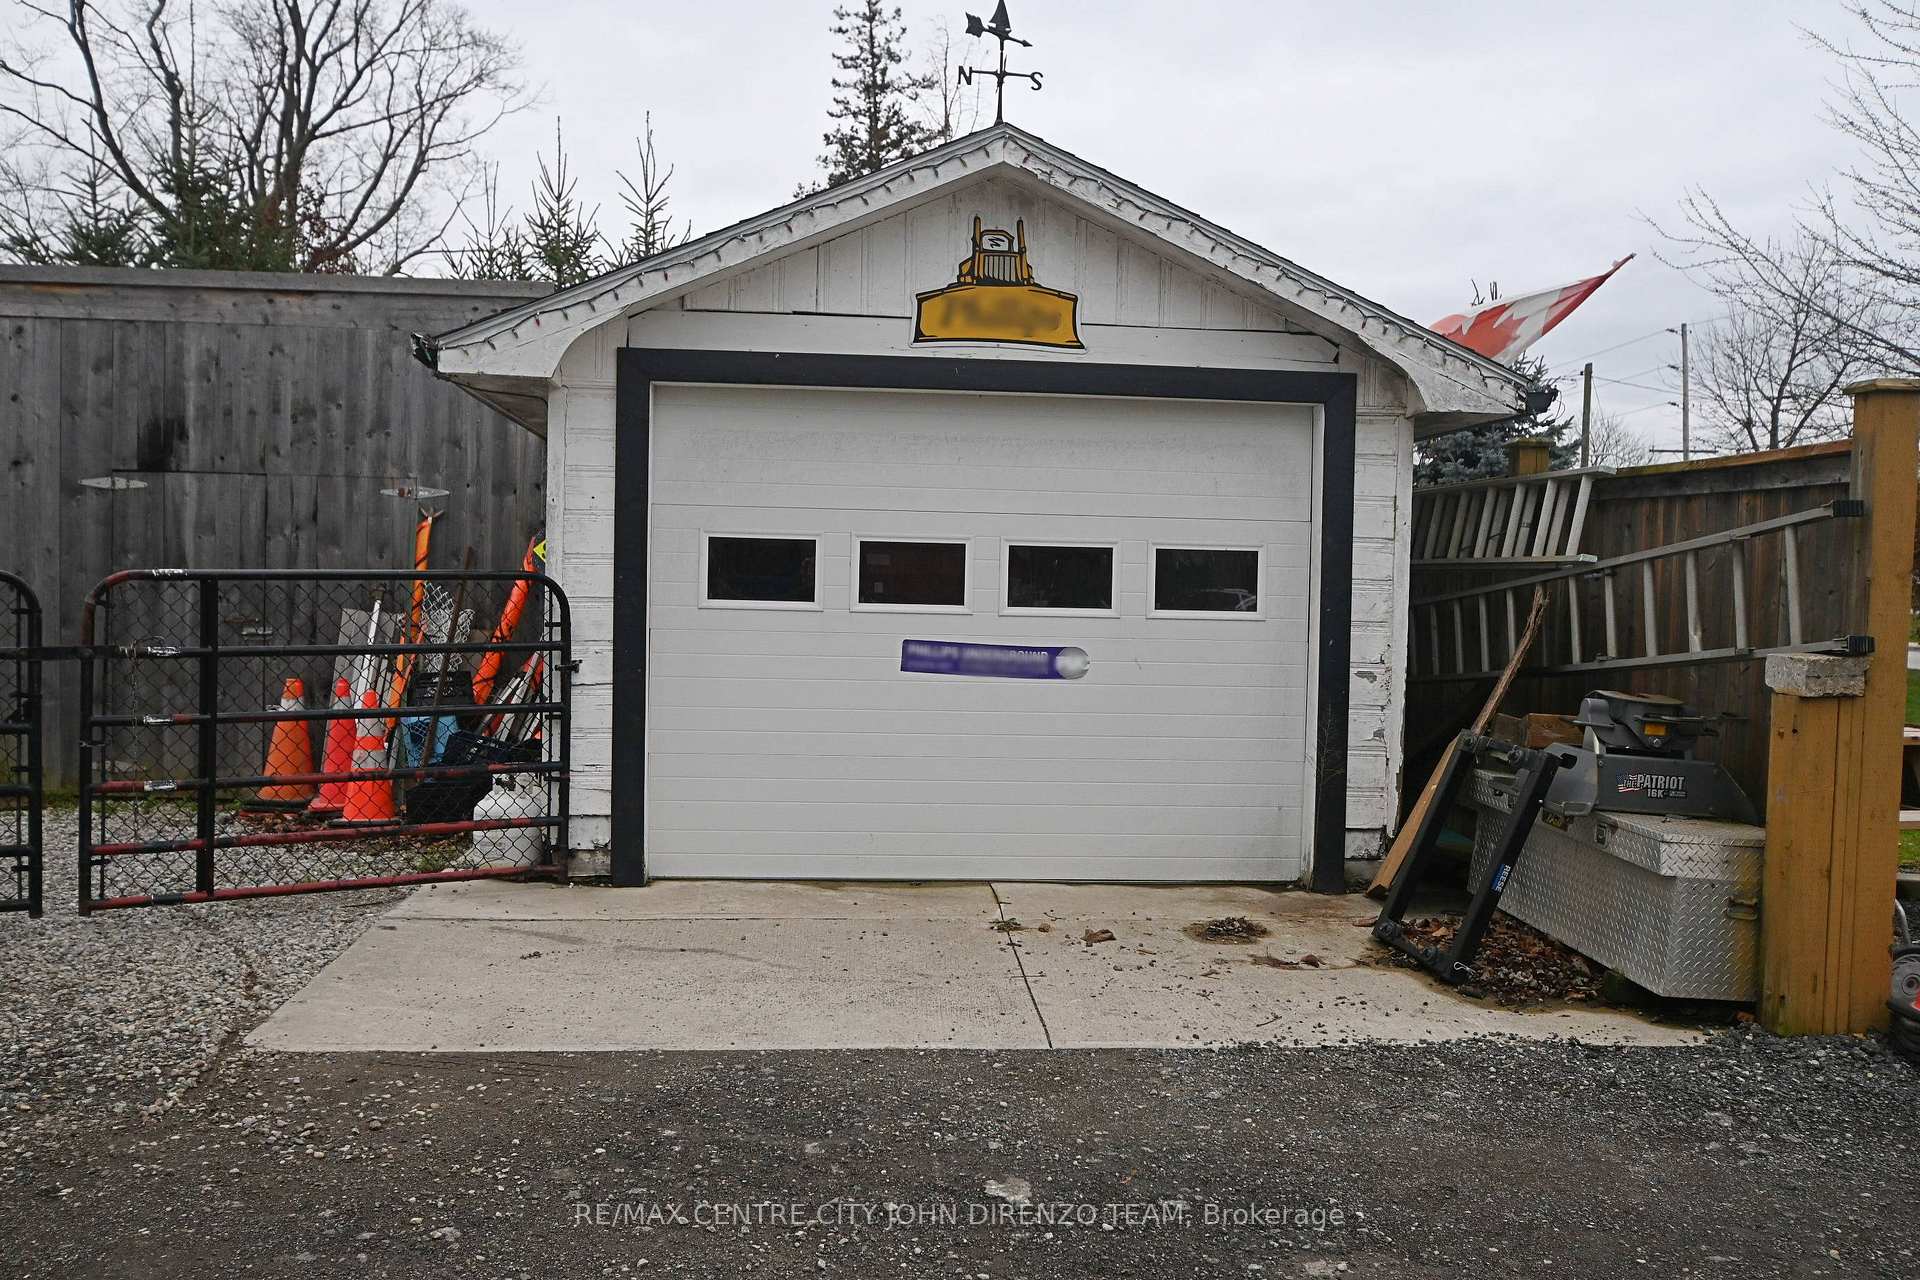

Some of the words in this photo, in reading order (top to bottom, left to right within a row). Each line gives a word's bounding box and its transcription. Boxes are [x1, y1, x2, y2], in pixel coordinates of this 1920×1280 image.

[958, 65, 972, 85] N
[1030, 71, 1044, 91] S
[1637, 773, 1685, 790] PATRIOT
[1647, 788, 1665, 799] 16K
[1494, 864, 1511, 893] REESE
